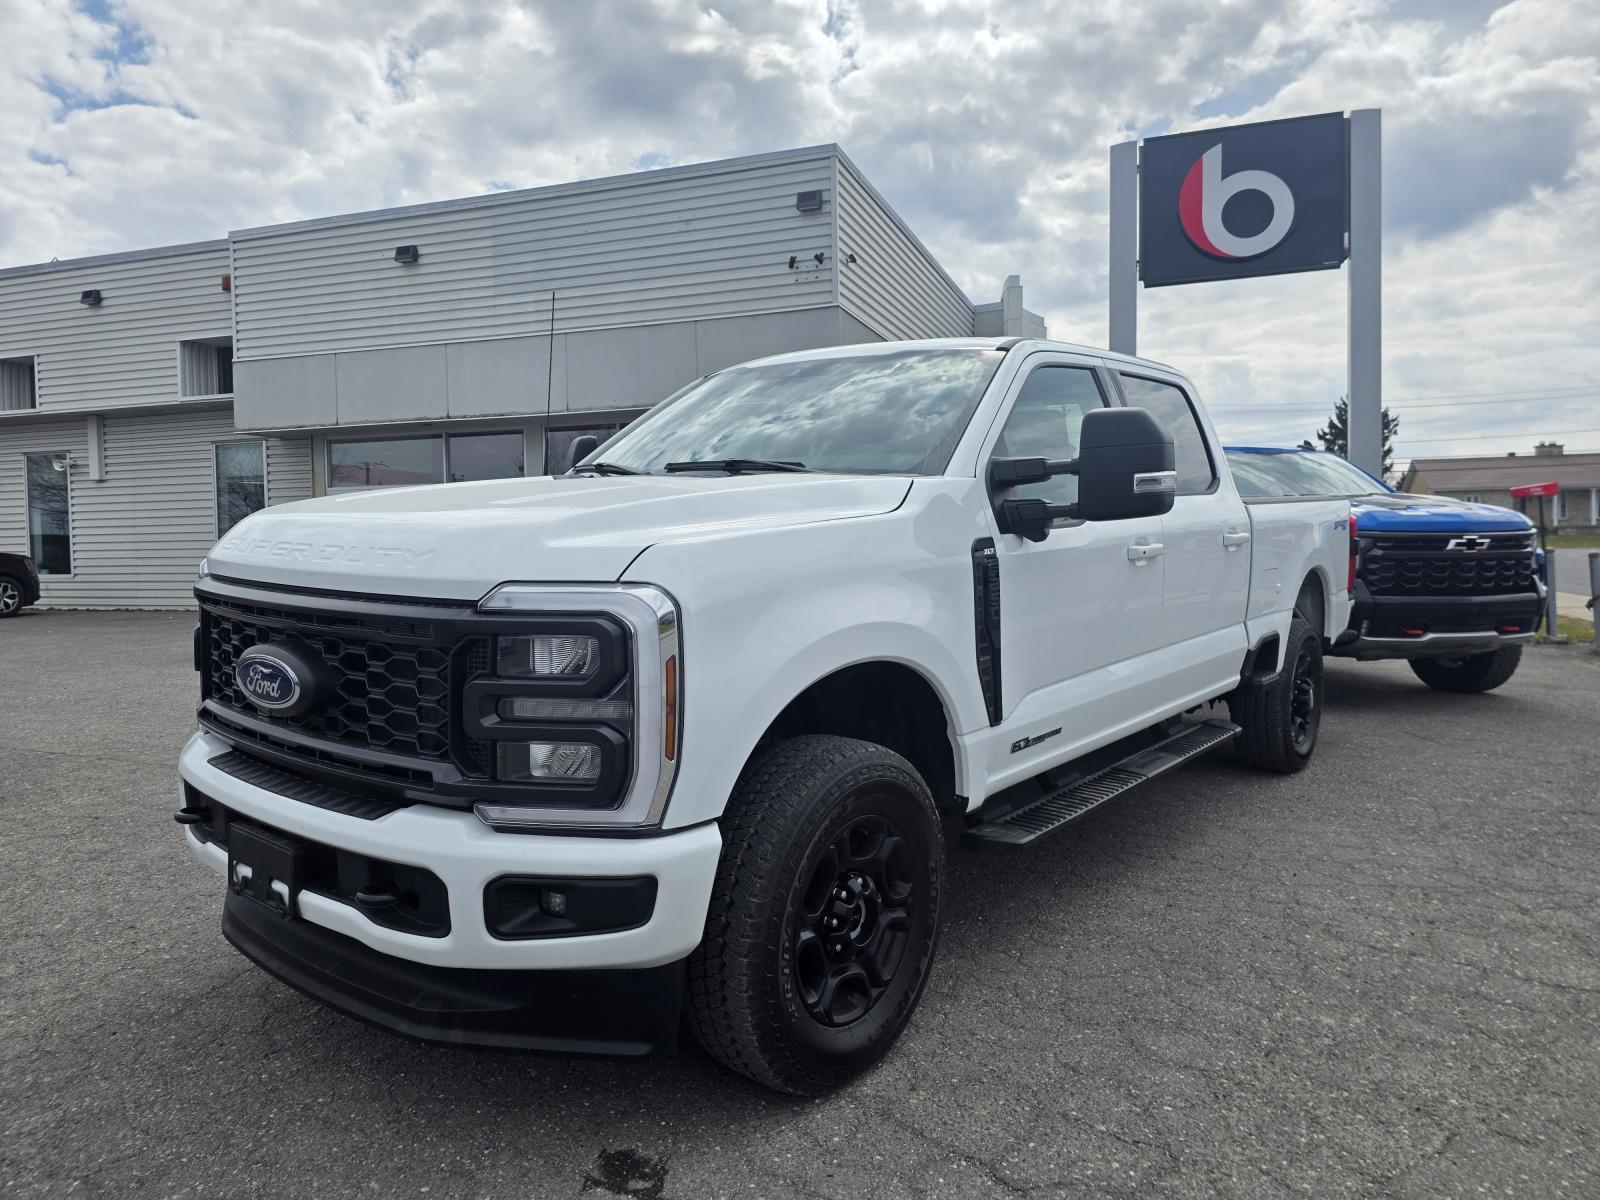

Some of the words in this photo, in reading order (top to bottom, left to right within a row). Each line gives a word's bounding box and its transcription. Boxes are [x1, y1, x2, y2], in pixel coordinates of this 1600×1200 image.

[220, 536, 313, 561] SUPER
[314, 544, 435, 568] DUTY
[246, 664, 282, 697] Ford
